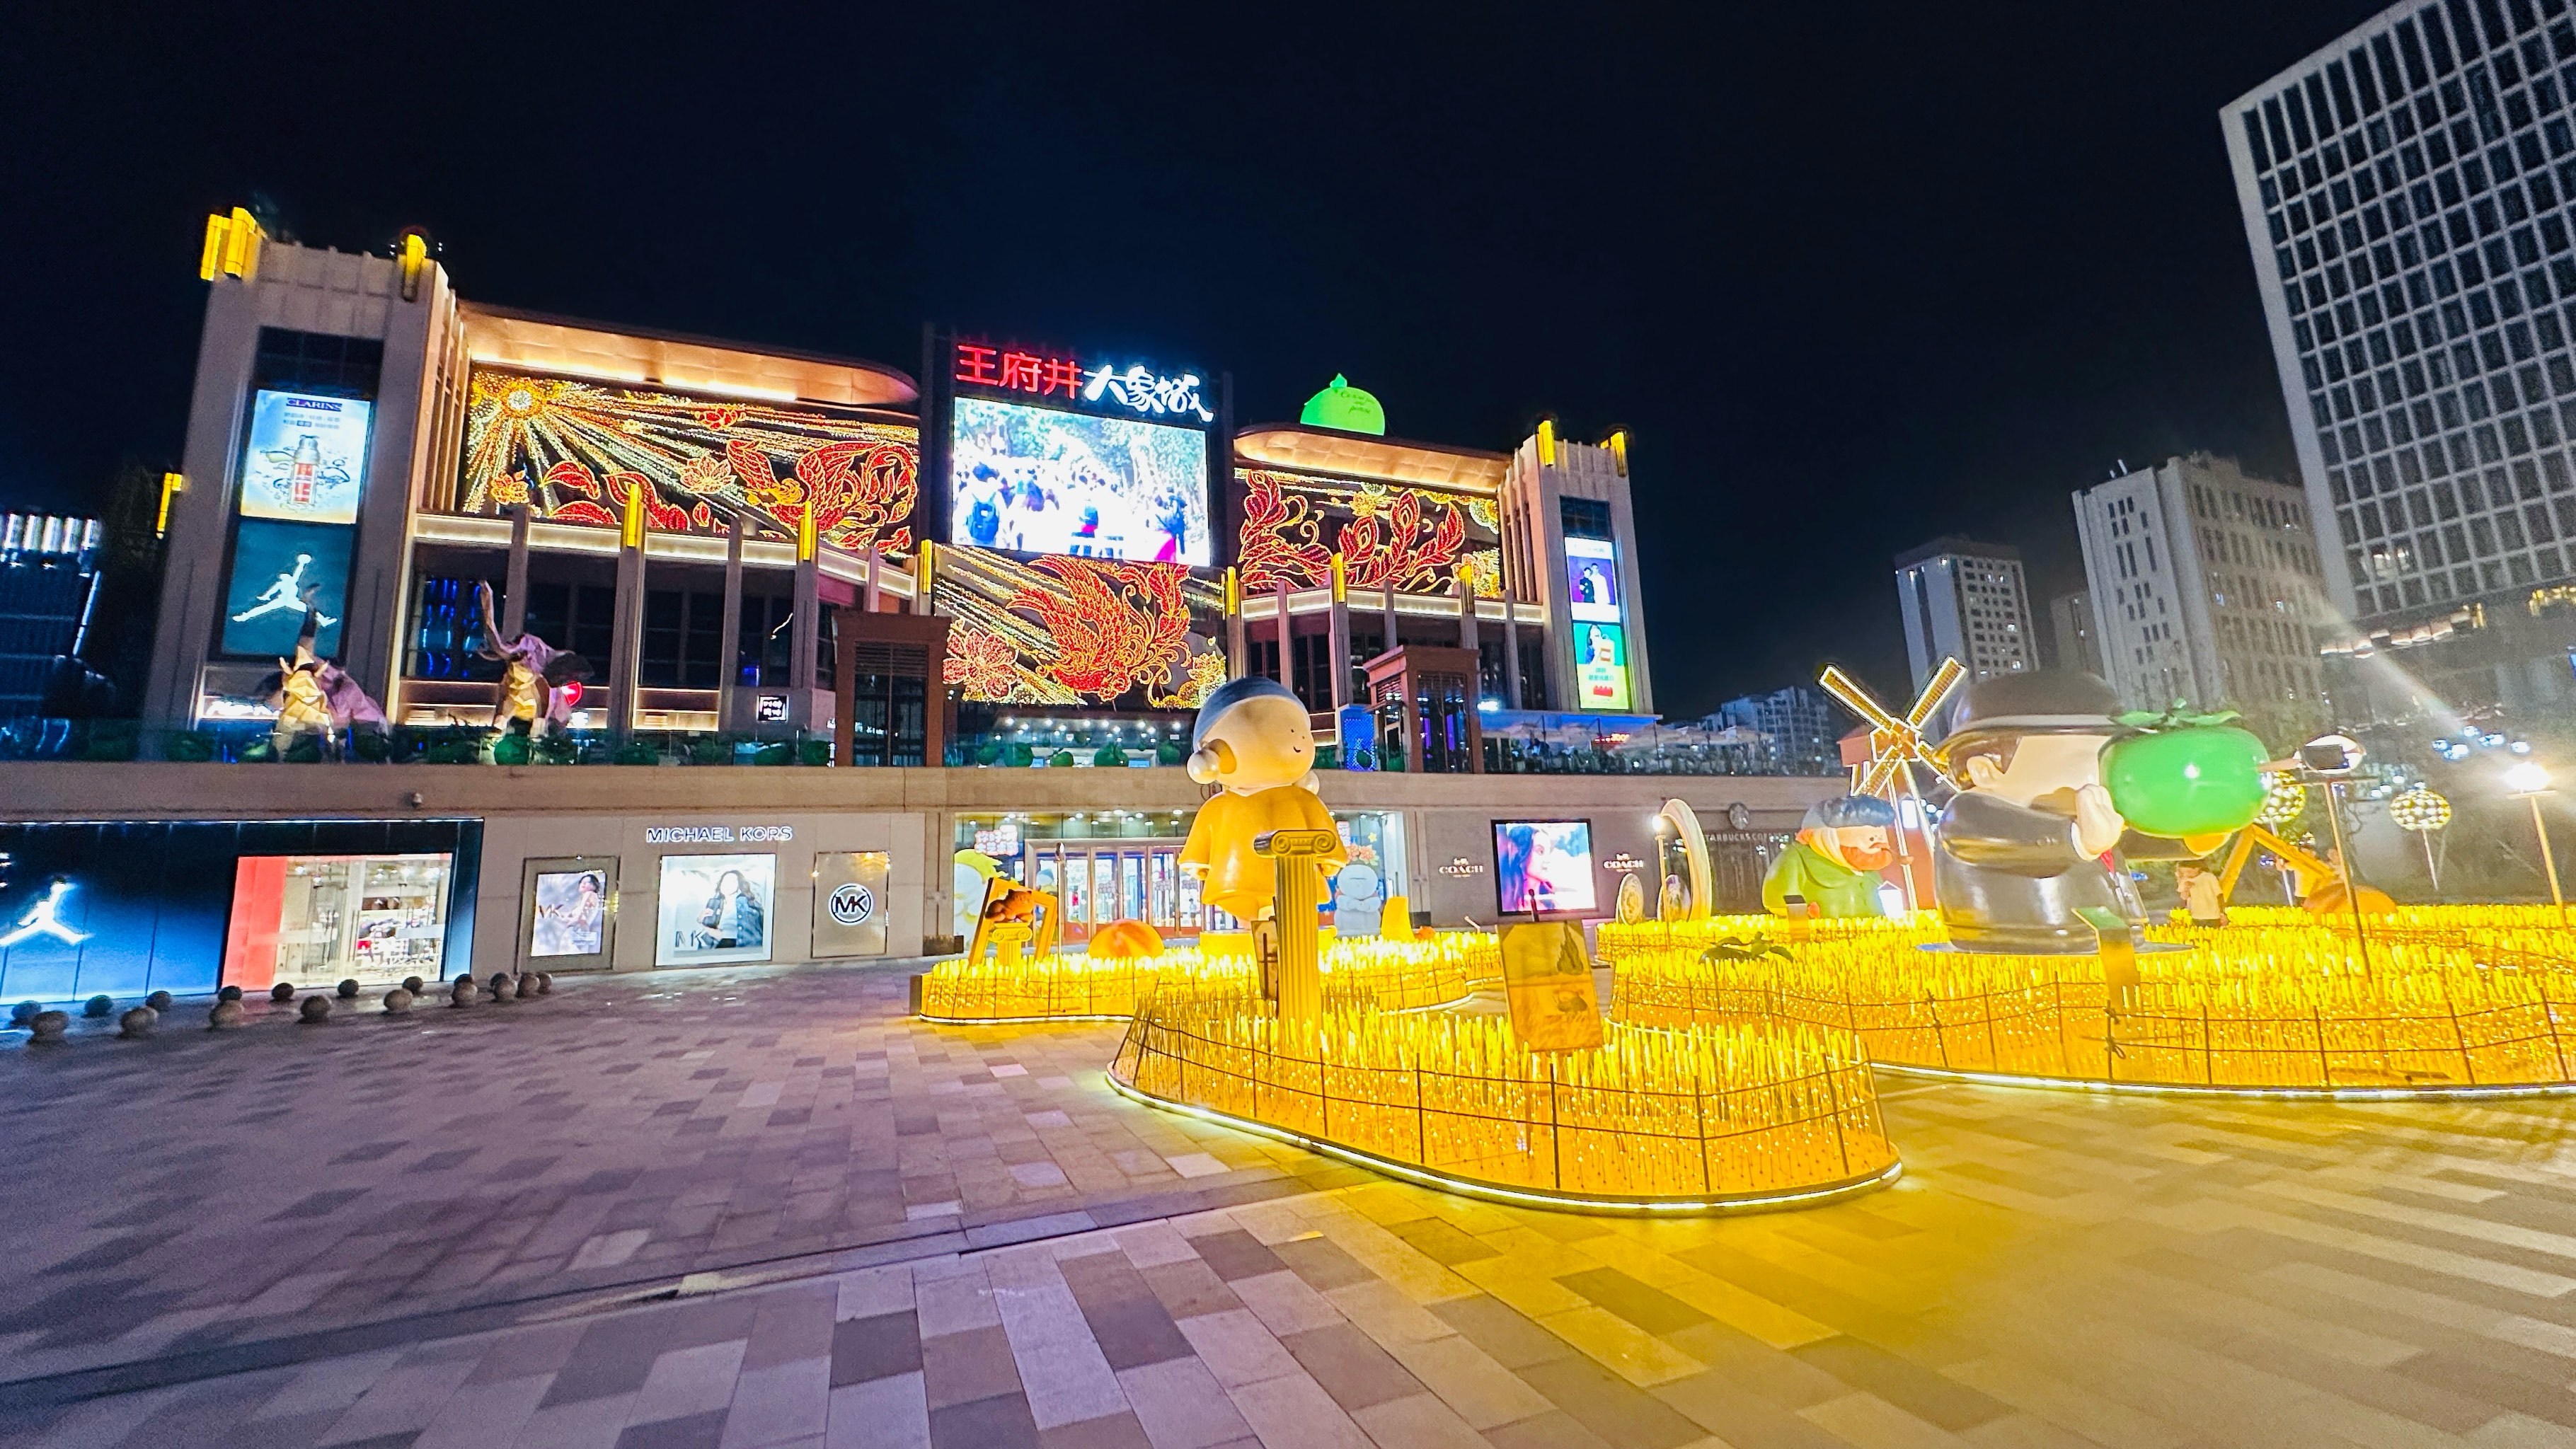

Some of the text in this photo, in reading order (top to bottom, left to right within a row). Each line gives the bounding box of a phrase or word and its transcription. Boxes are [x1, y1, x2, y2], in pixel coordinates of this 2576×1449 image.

[955, 344, 1083, 400] 王府井
[1083, 364, 1214, 423] 大象城
[286, 398, 343, 411] CLARINS
[646, 826, 793, 843] MICHAEL KORS
[1706, 833, 1751, 842] TARBUCKS
[1438, 865, 1484, 874] COACH
[1602, 860, 1644, 869] COACH
[834, 894, 868, 913] MK
